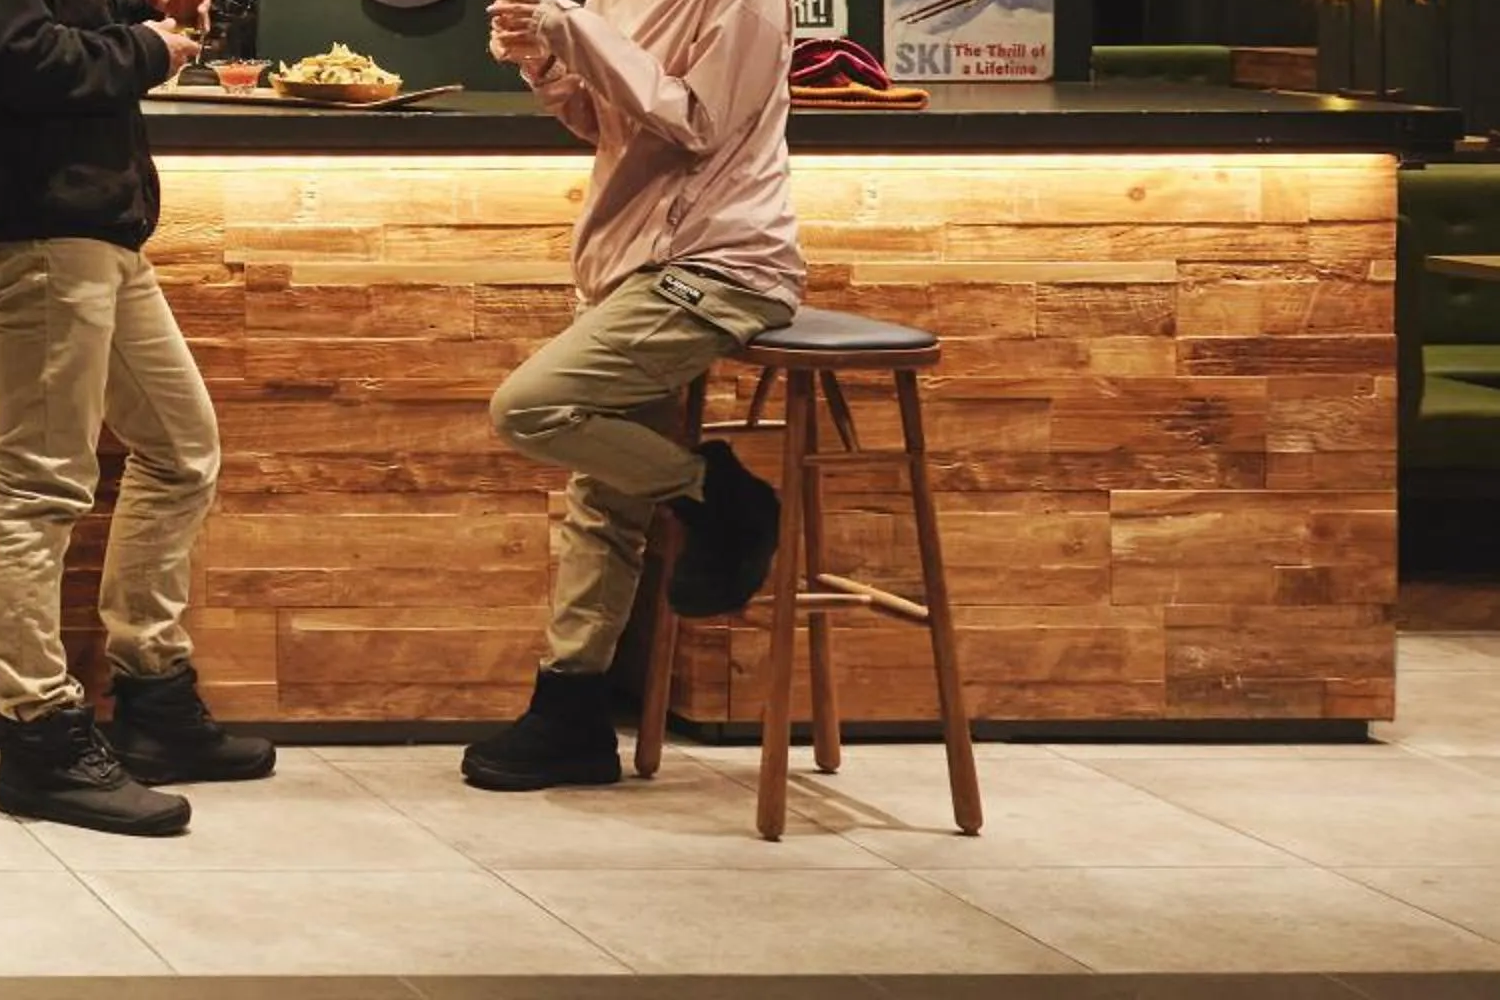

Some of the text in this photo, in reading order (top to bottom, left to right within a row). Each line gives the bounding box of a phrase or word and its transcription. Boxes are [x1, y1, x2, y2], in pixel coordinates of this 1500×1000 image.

[894, 42, 1046, 76] SKI The Thrill of
[975, 61, 1038, 76] Lifetime
